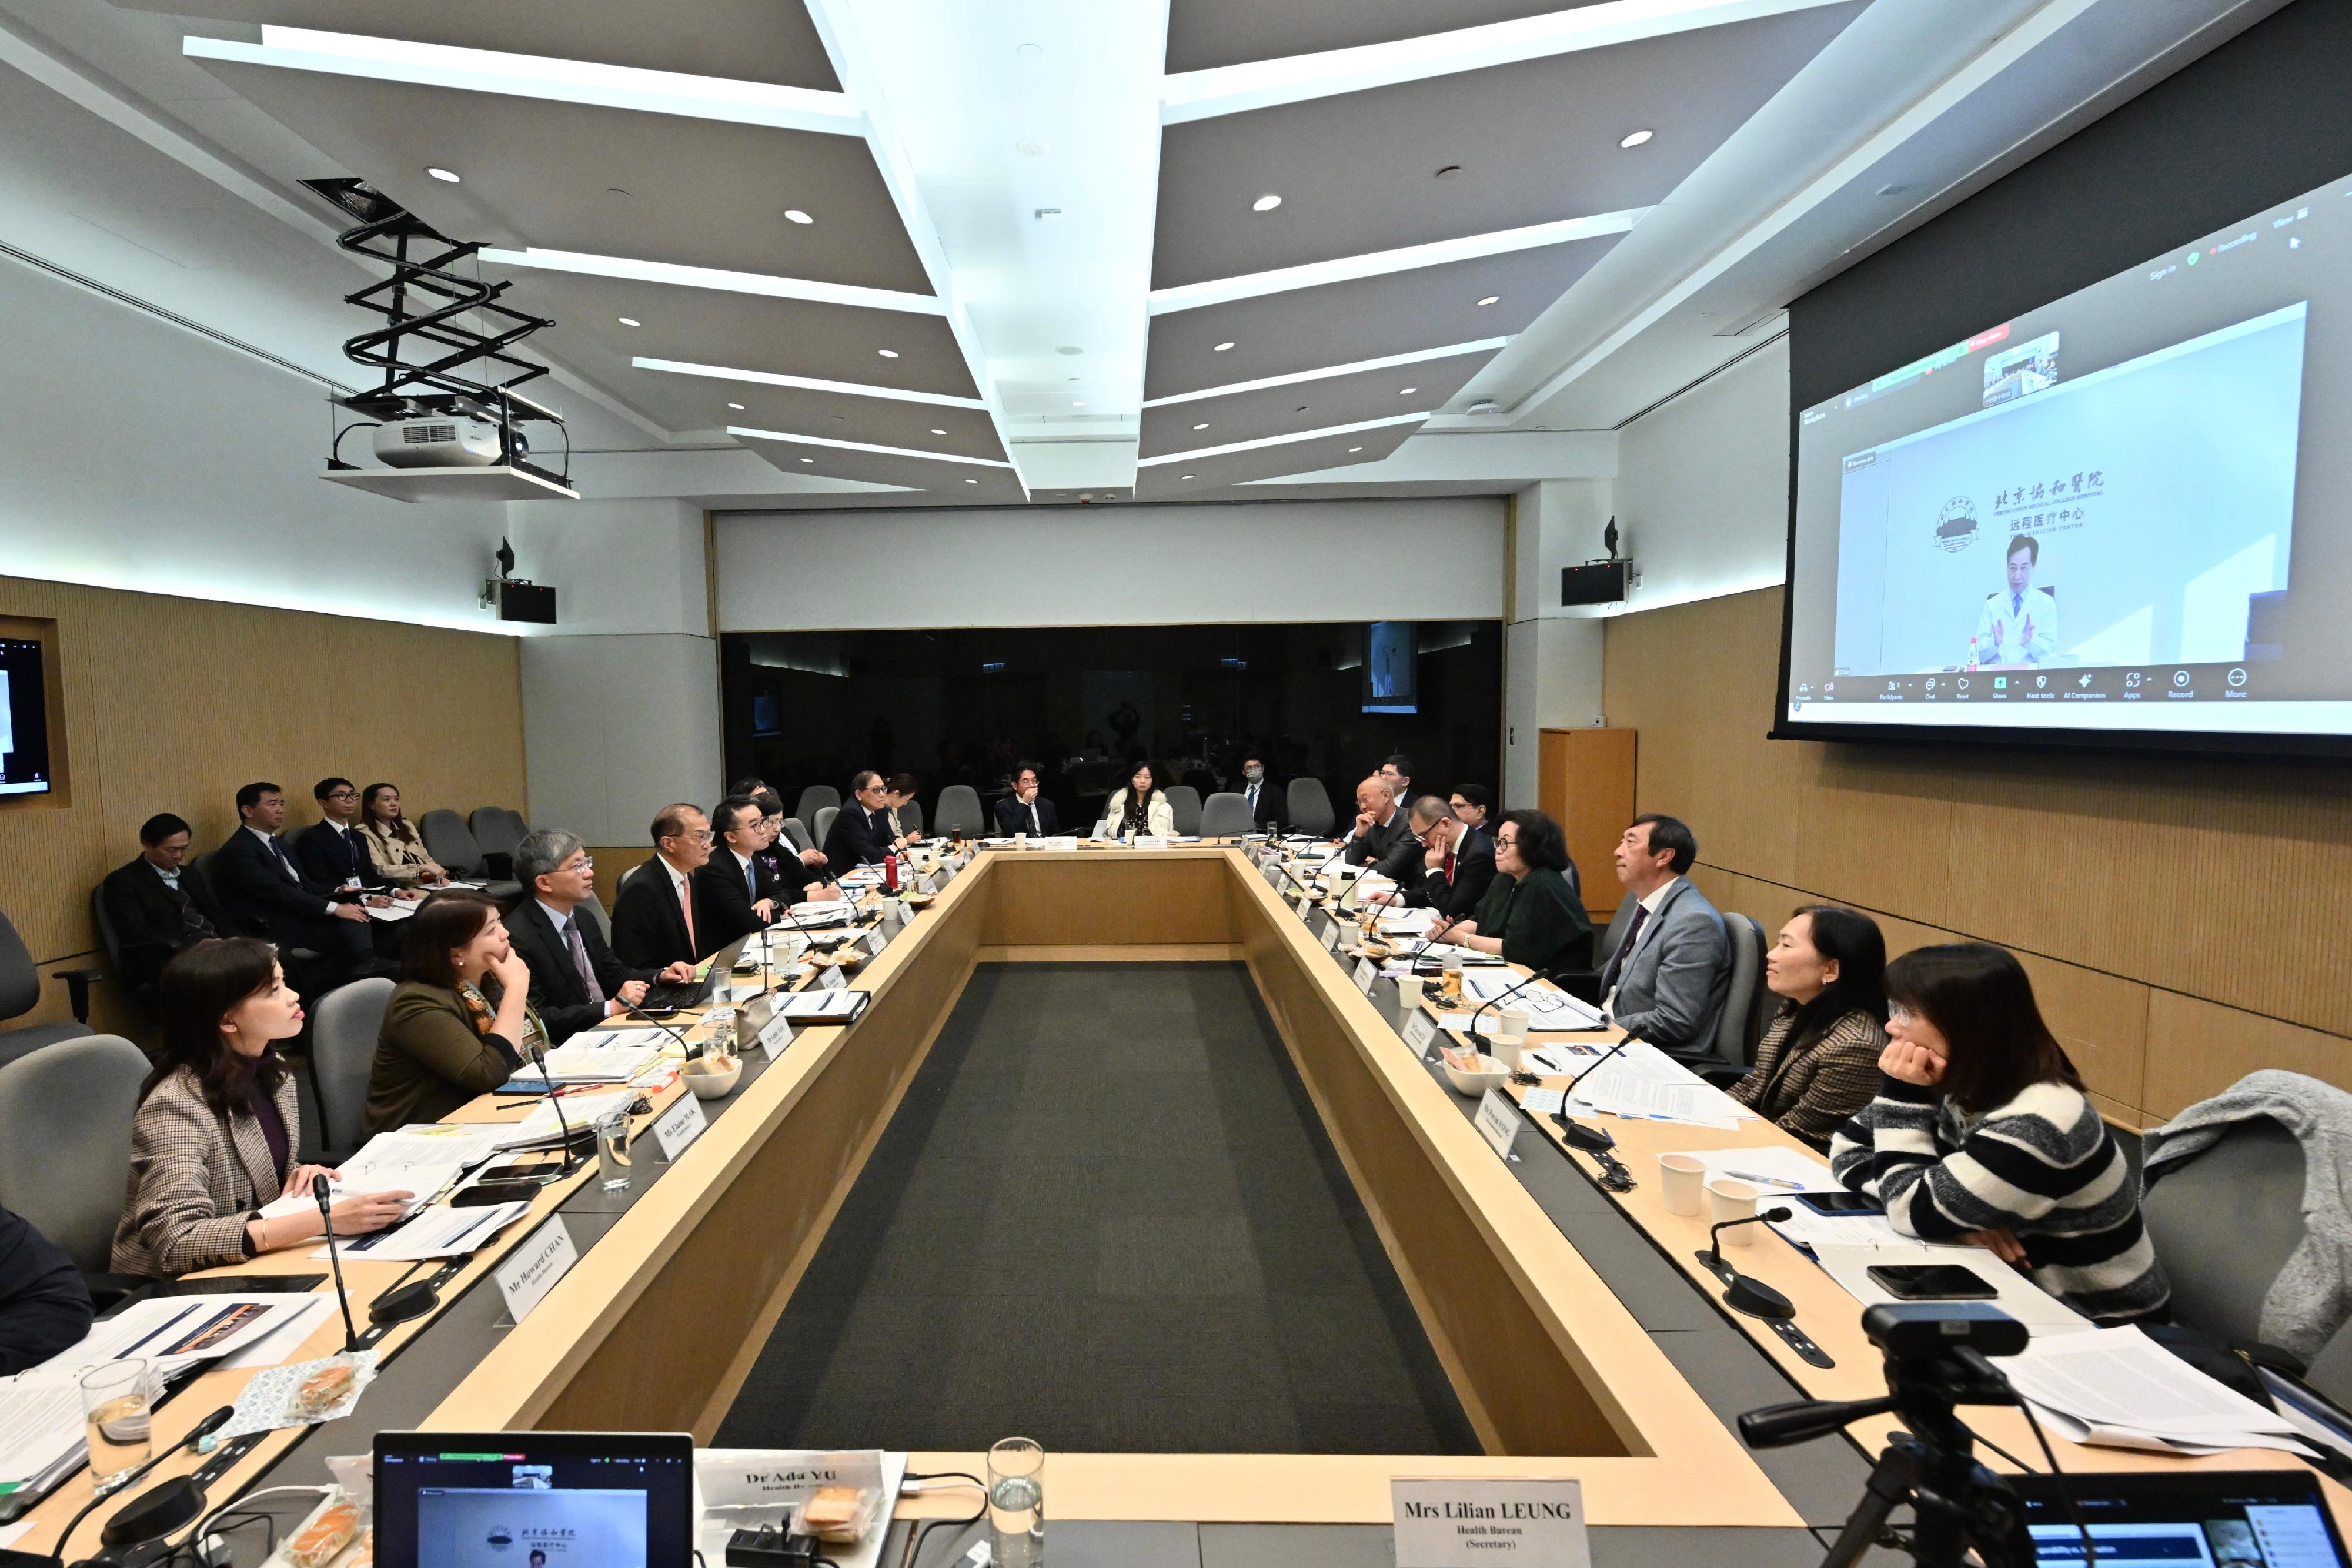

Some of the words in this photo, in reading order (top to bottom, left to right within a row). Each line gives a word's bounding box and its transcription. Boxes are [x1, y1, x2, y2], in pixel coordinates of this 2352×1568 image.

[2217, 232, 2258, 253] Recording
[2150, 269, 2167, 280] Sign
[2168, 265, 2176, 274] in
[1804, 413, 1826, 425] Workplace
[2029, 501, 2052, 509] MEDICAL
[2010, 507, 2084, 531] 远程医疗中心
[2059, 522, 2083, 531] CENTER
[2124, 692, 2141, 700] Apps
[509, 1282, 520, 1294] Mr
[520, 1253, 546, 1285] Howard
[746, 1473, 770, 1483] Dr
[773, 1471, 805, 1482] Ada
[810, 1470, 836, 1480] YU
[1405, 1502, 1439, 1519] Mrs
[1444, 1502, 1495, 1519] Lilian
[1501, 1502, 1571, 1520] LEUNG
[1457, 1525, 1488, 1535] Health
[1489, 1526, 1522, 1535] Bureau
[1466, 1539, 1516, 1550] (Secretary)
